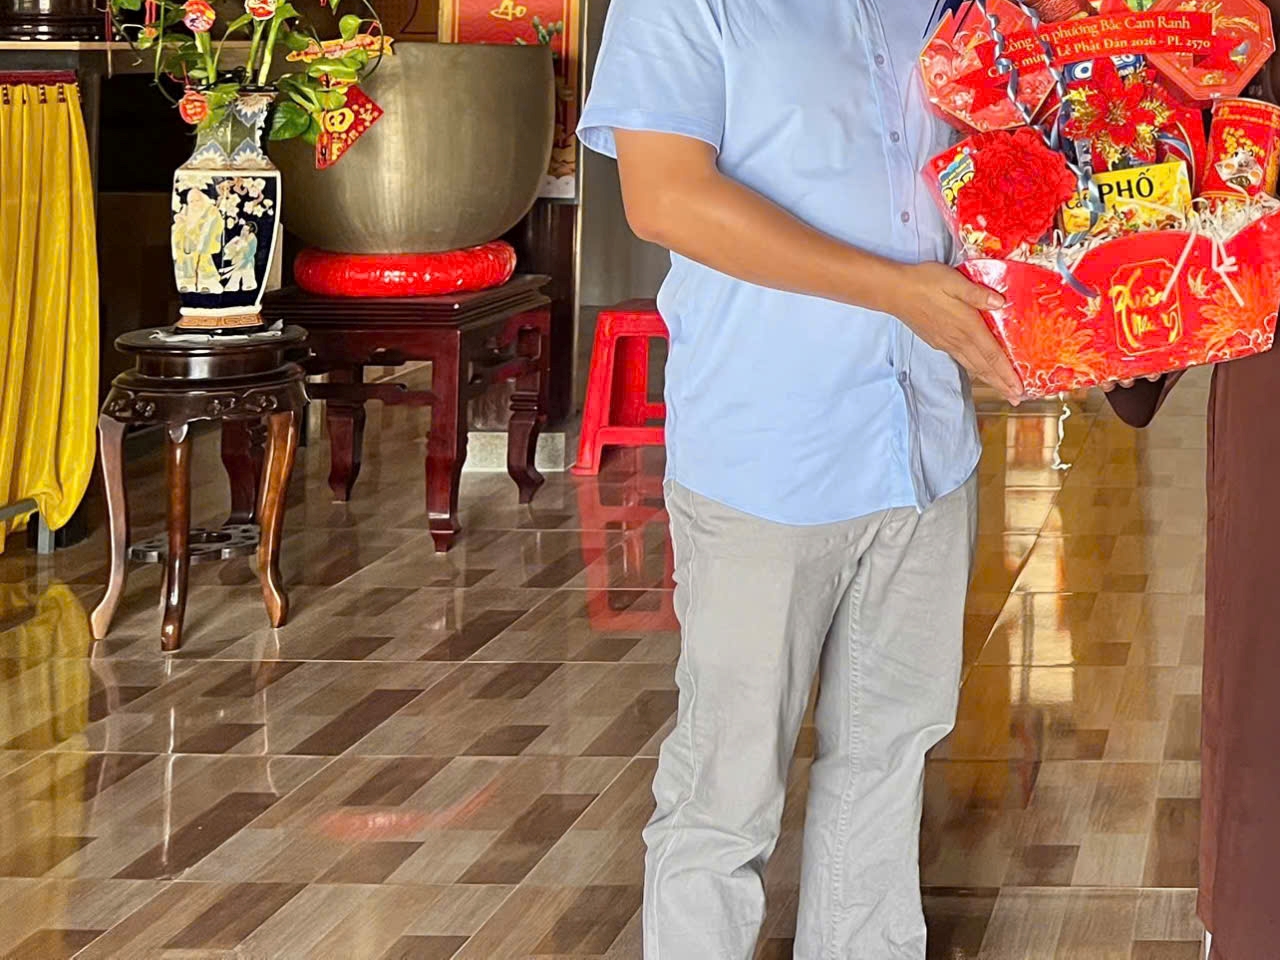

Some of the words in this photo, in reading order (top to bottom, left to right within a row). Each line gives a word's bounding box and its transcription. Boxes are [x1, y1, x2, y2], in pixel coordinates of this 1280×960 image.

[1052, 21, 1099, 45] phường
[1100, 18, 1121, 32] Bắc
[1124, 16, 1155, 30] Cam
[1157, 15, 1191, 30] Ranh
[1073, 40, 1100, 54] Phật
[1131, 37, 1157, 47] 2026
[1186, 38, 1211, 50] 2570
[1097, 168, 1154, 204] PHỐ
